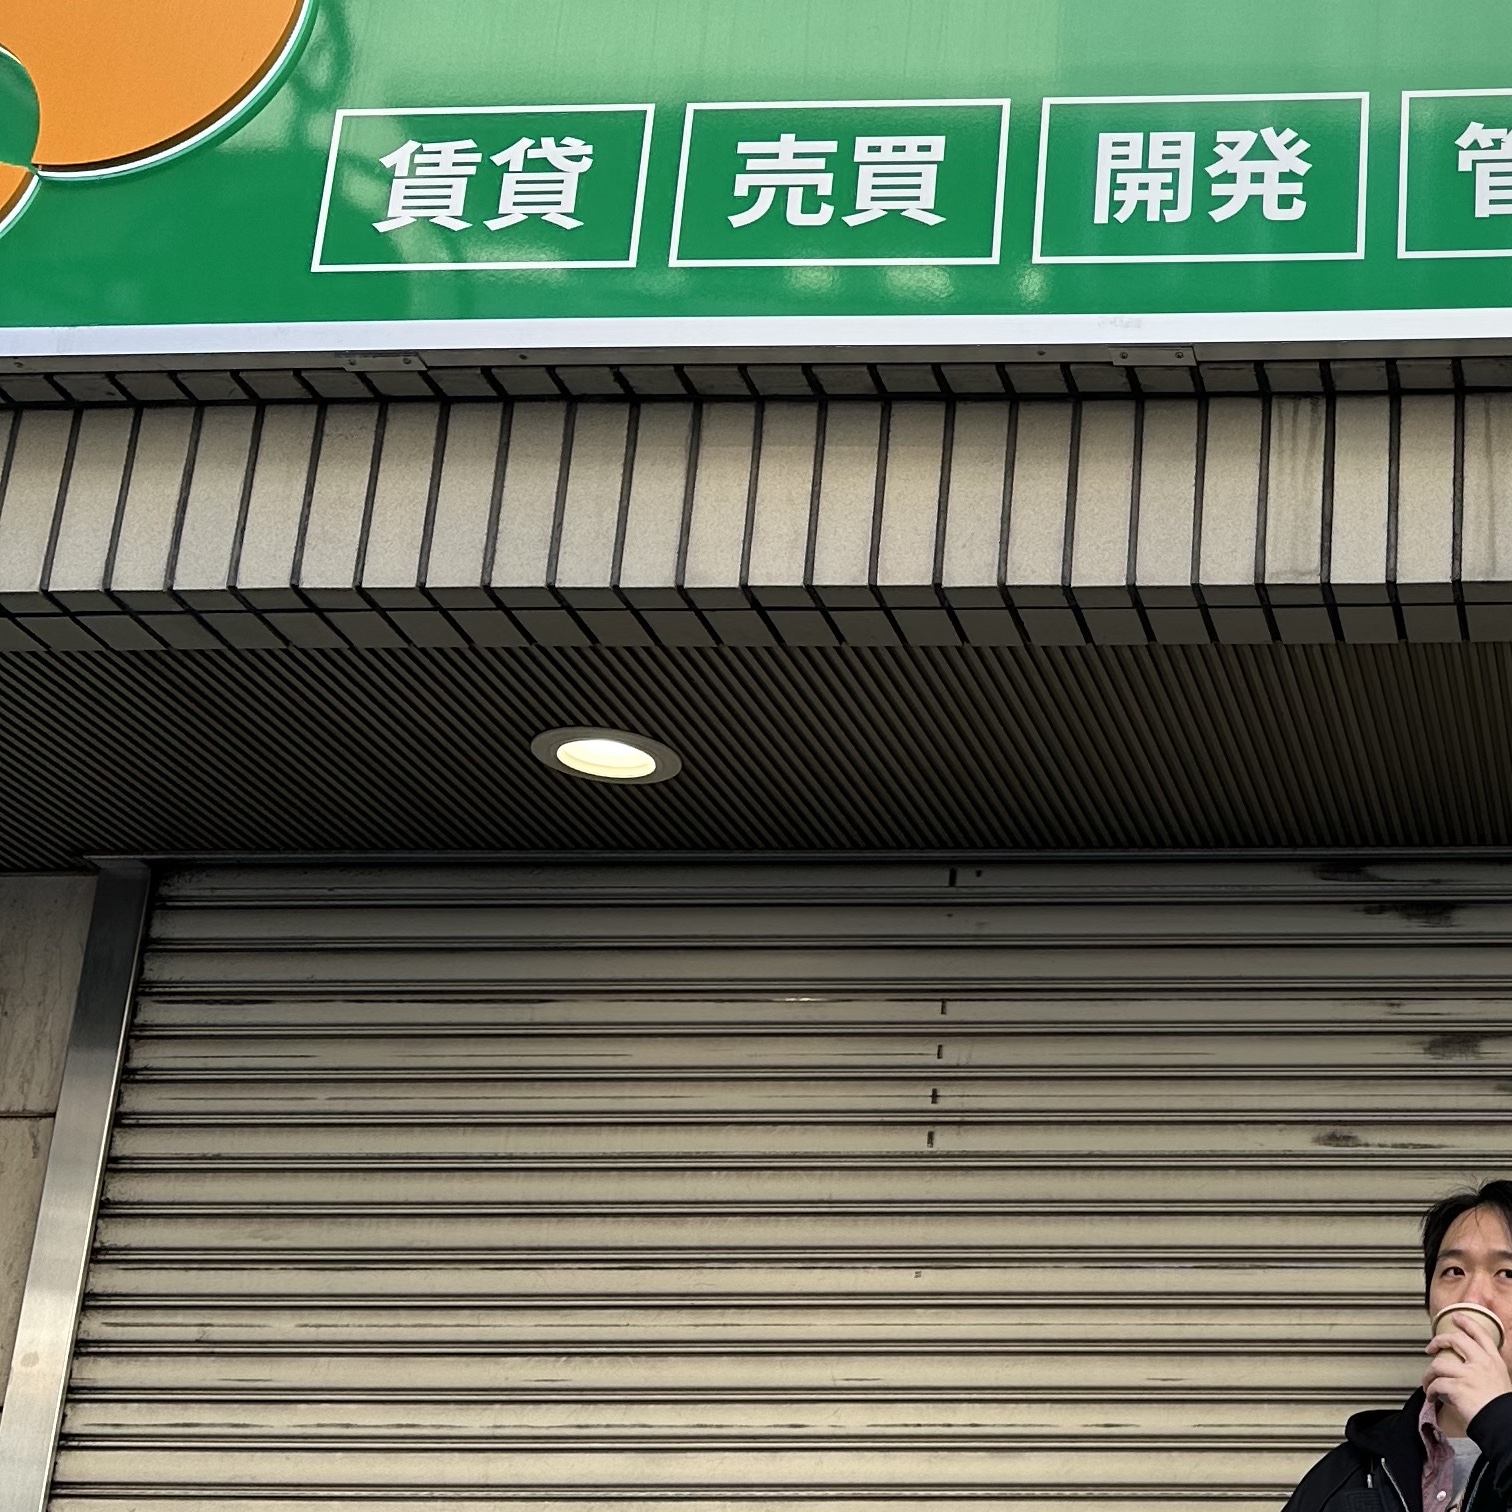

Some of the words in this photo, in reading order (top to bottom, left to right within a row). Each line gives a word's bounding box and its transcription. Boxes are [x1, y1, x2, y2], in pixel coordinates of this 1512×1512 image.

[373, 136, 594, 233] 賃貸
[727, 133, 947, 228] 売買
[1093, 126, 1313, 225] 開発
